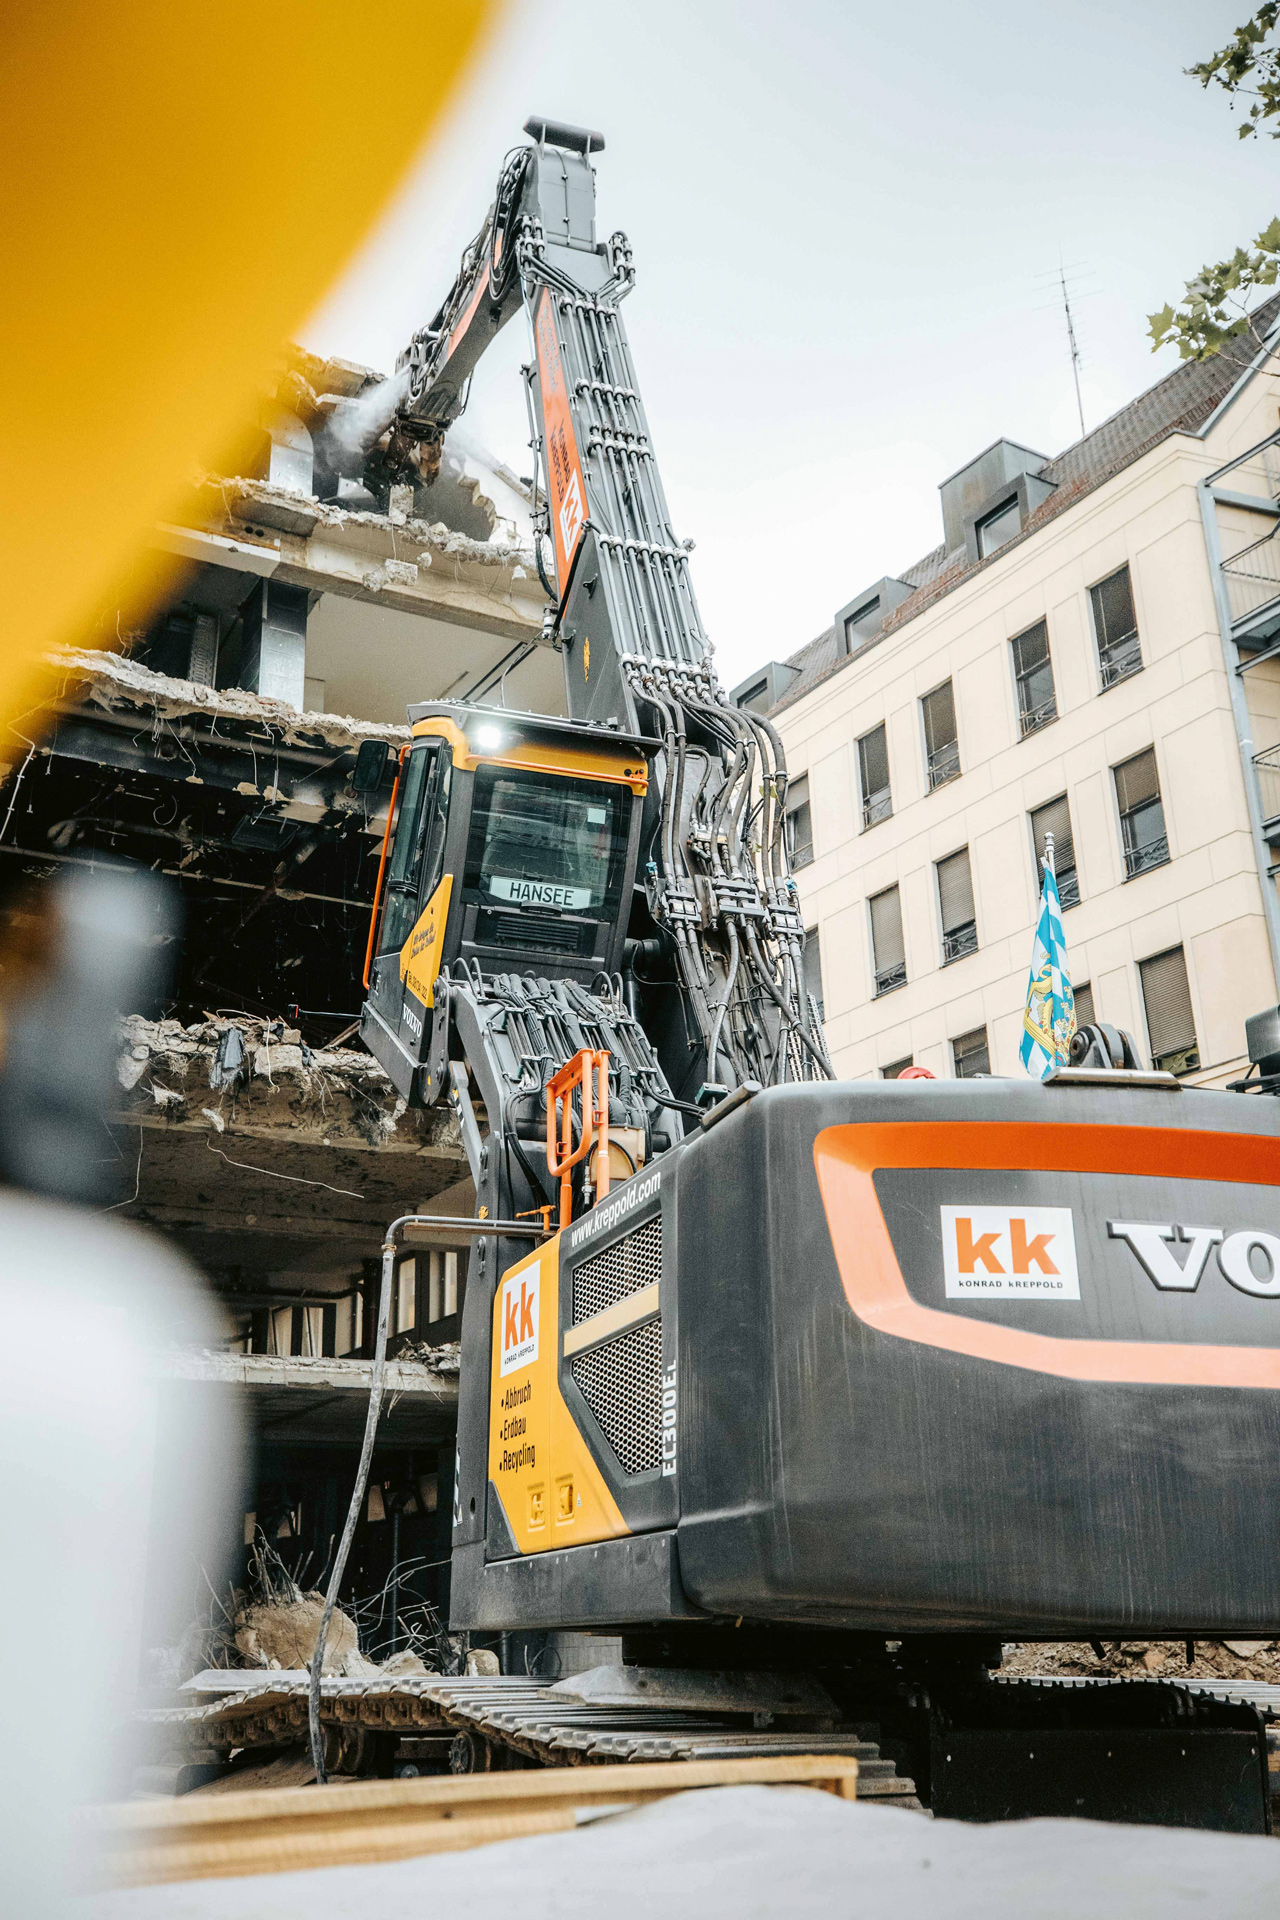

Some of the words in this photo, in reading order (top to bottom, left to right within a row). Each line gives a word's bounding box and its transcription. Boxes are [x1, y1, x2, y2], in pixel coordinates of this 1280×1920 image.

[509, 882, 574, 906] HANSEE
[403, 1003, 423, 1037] VOLVO
[571, 1171, 661, 1247] www.kreppold.com
[955, 1217, 1061, 1275] kk
[505, 1281, 535, 1352] kk
[505, 1379, 531, 1411] Abbruch
[503, 1416, 526, 1441] Erdbau
[662, 1359, 677, 1477] EC300EL
[503, 1442, 535, 1473] Recycling
